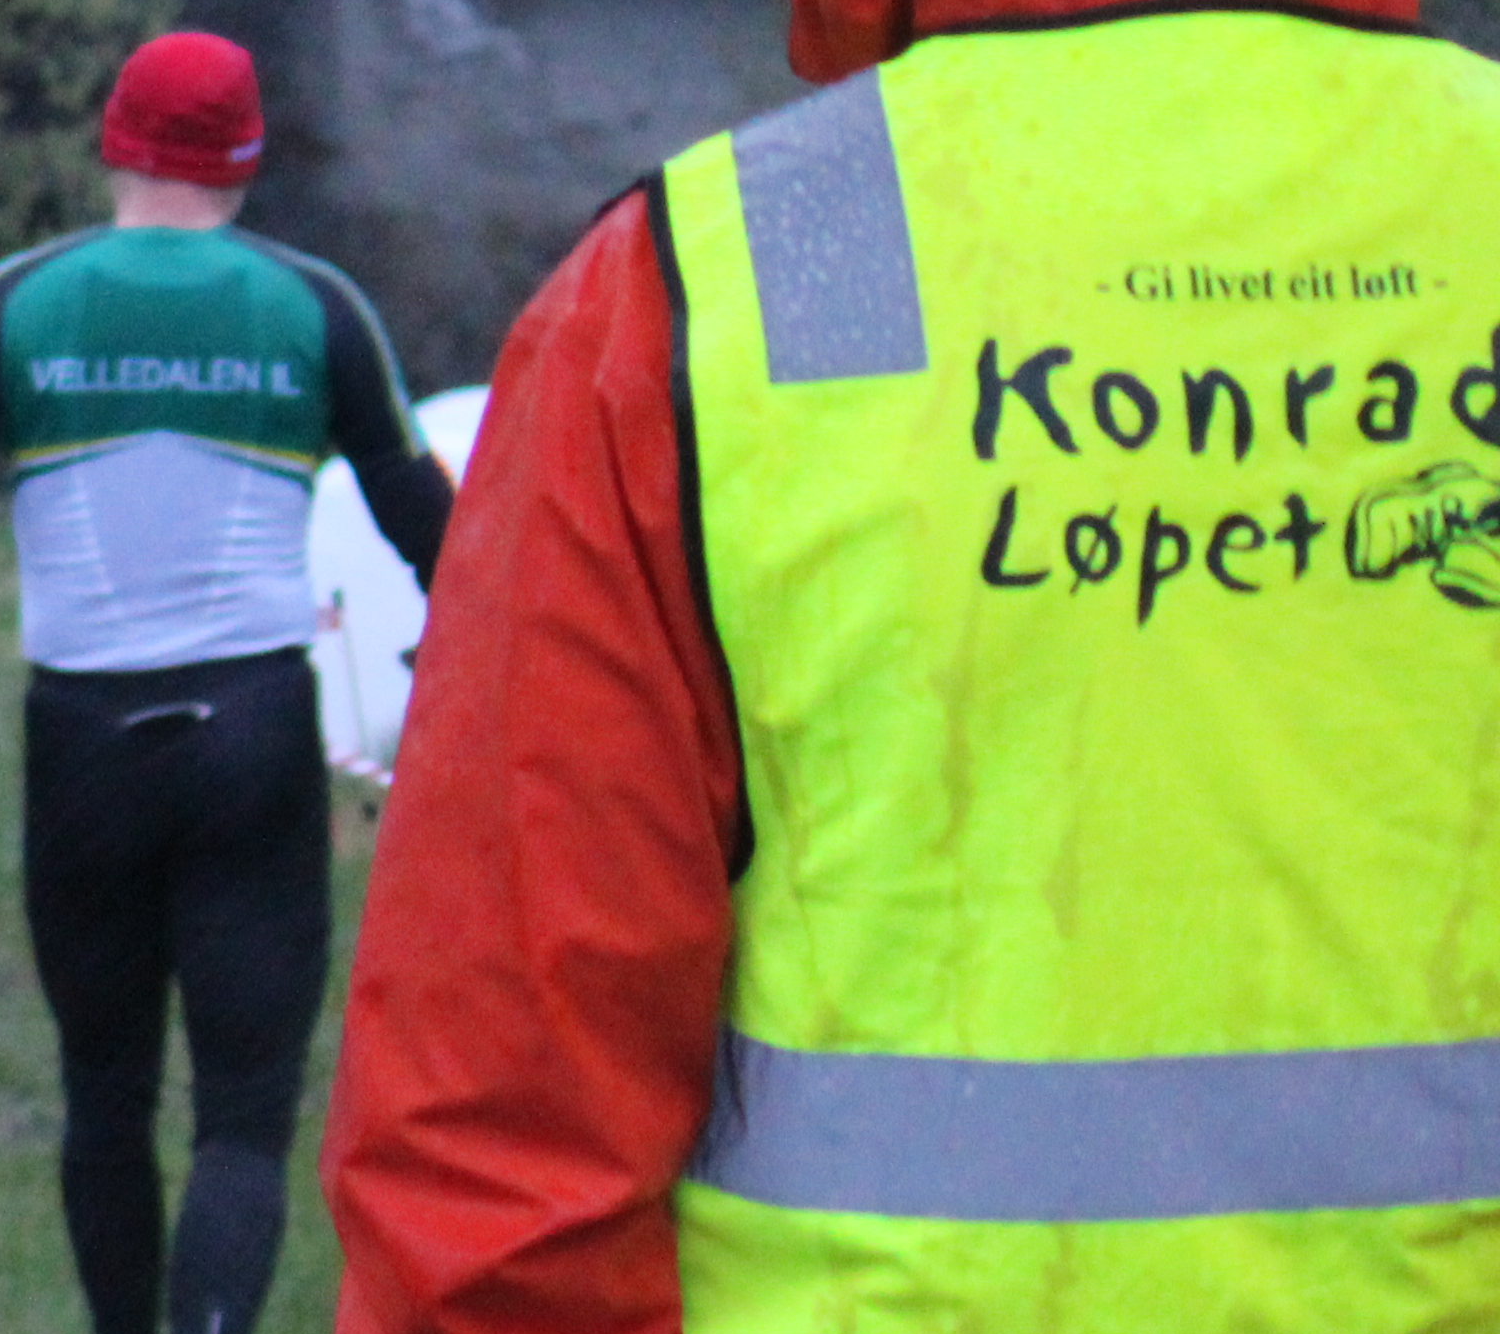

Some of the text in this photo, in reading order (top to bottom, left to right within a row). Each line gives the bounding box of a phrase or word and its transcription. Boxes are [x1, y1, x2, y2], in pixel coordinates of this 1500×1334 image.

[1124, 264, 1175, 300] Gi
[1189, 264, 1274, 300] livet
[1289, 265, 1336, 300] eit
[1351, 263, 1419, 299] løft
[31, 357, 302, 396] VELLEDALEN IL
[973, 321, 1500, 463] Konrad
[980, 484, 1327, 628] Løpet
